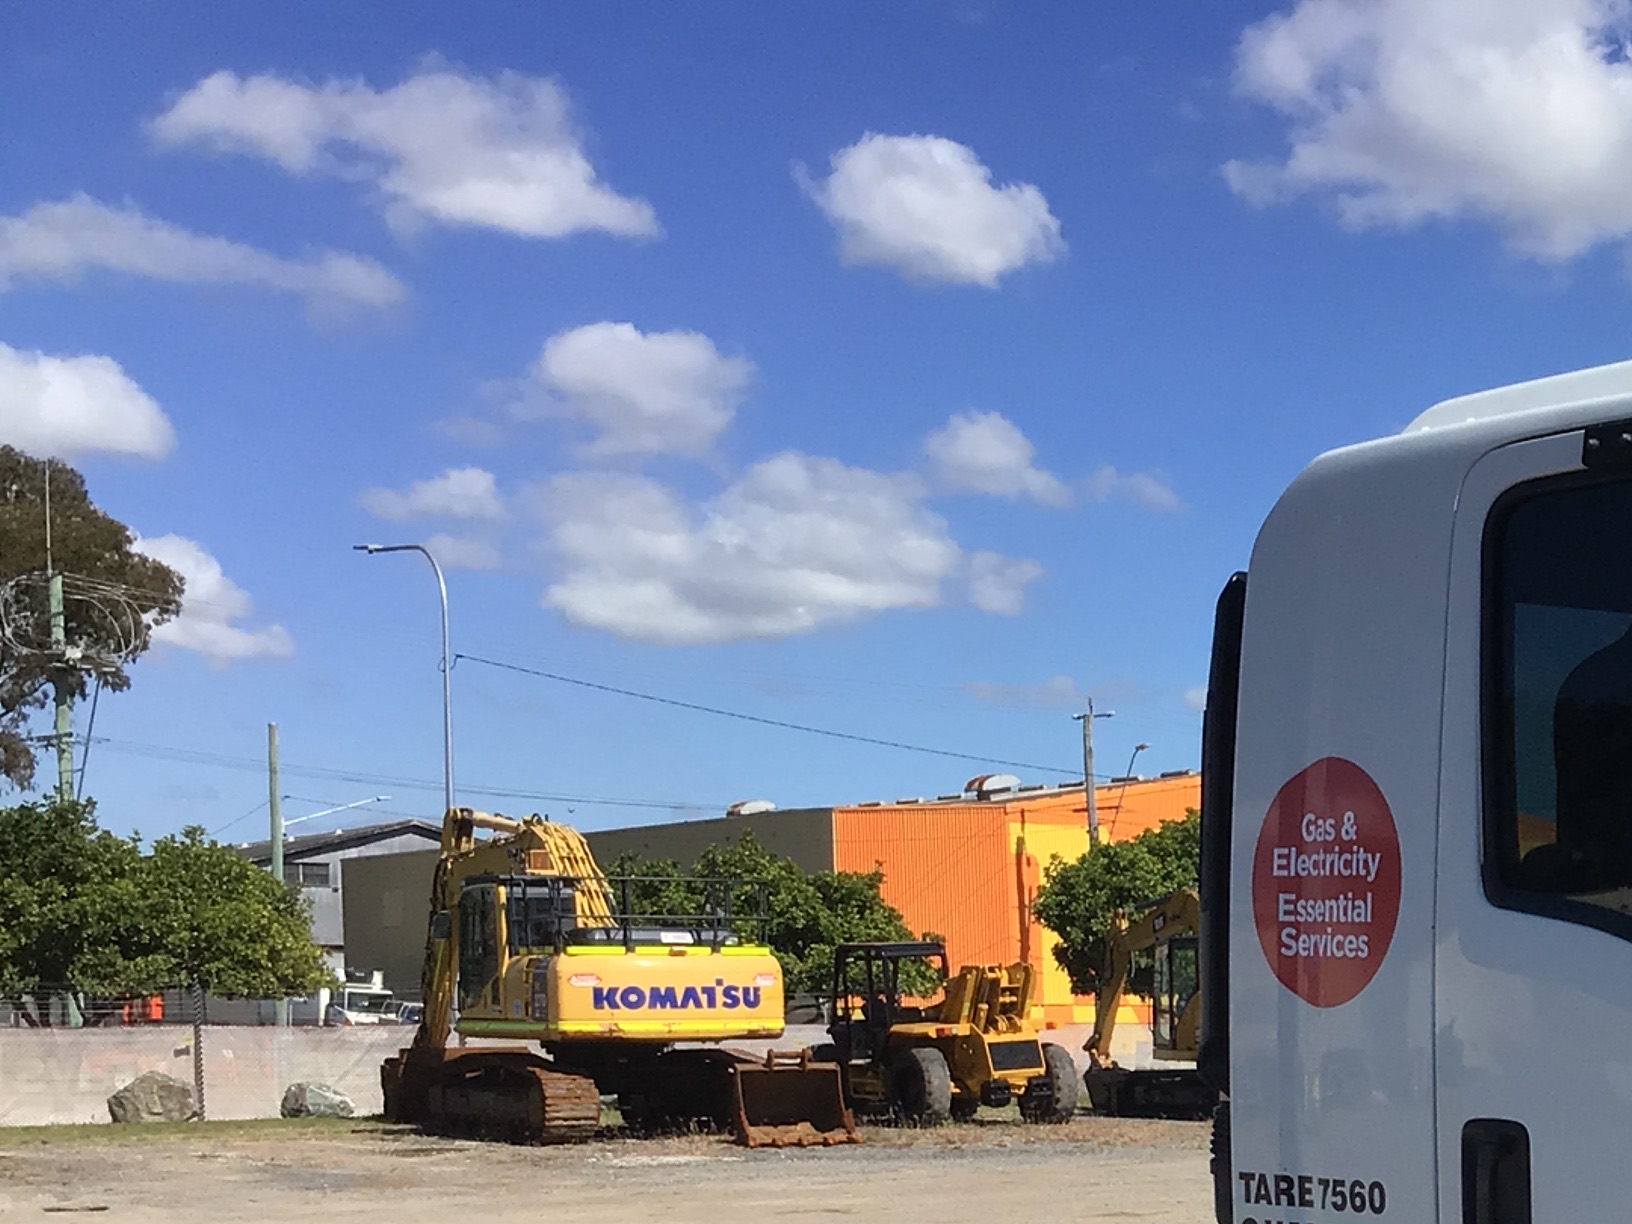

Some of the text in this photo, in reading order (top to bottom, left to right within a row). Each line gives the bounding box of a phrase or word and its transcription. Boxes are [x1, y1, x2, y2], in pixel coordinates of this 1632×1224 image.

[1302, 811, 1357, 842] Gas &
[1272, 845, 1381, 882] Electricity
[1278, 892, 1373, 923] Essential
[1280, 926, 1369, 958] Services
[593, 979, 761, 1010] KOMATSU
[1239, 1172, 1387, 1215] TARE 7560
